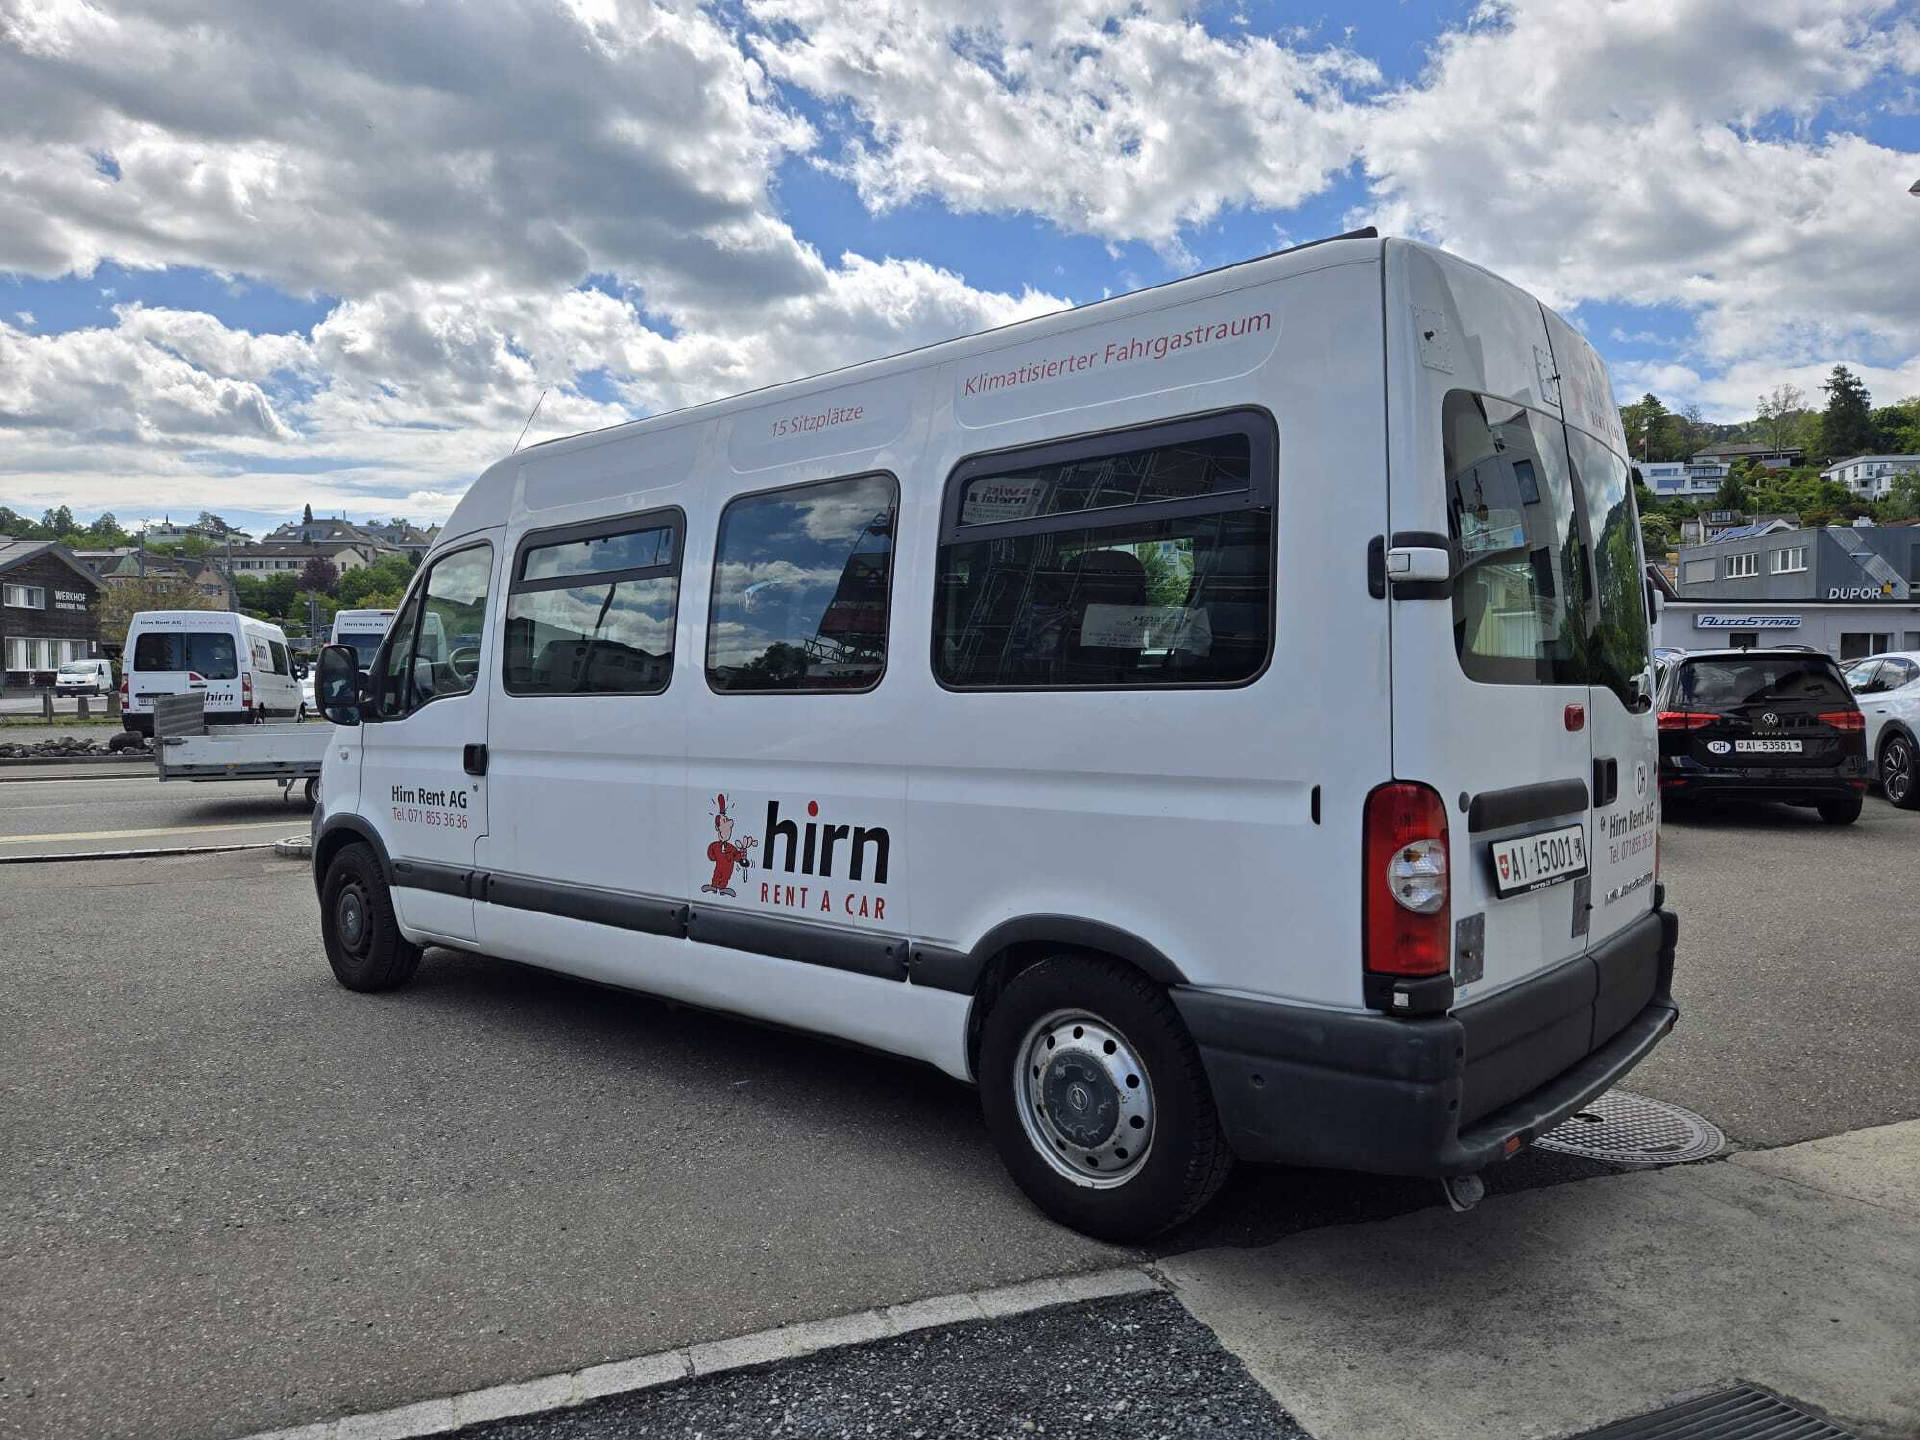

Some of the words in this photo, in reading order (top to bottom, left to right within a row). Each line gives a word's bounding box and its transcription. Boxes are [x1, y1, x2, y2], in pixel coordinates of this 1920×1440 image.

[964, 353, 1097, 397] Klimatisierter
[1104, 312, 1272, 364] Fahrgastraum
[770, 420, 788, 437] 15
[790, 403, 864, 436] Sitzplätze
[54, 590, 86, 602] WERKHOF
[1828, 587, 1882, 600] DUPOR
[205, 692, 234, 702] hirn
[1712, 742, 1726, 752] CH
[1637, 766, 1646, 794] CH
[391, 785, 414, 804] Hirn
[418, 788, 446, 807] Rent
[449, 791, 467, 809] AG
[392, 807, 407, 821] Tel.
[408, 809, 423, 823] 071
[426, 811, 441, 826] 855
[444, 813, 455, 827] 36
[456, 814, 468, 829] 36
[1609, 812, 1628, 839] Hirn
[1629, 807, 1645, 830] Rent
[1645, 802, 1654, 824] AG
[762, 799, 890, 885] hirn
[760, 882, 808, 908] RENT
[820, 890, 831, 913] A
[844, 893, 886, 919] CAR
